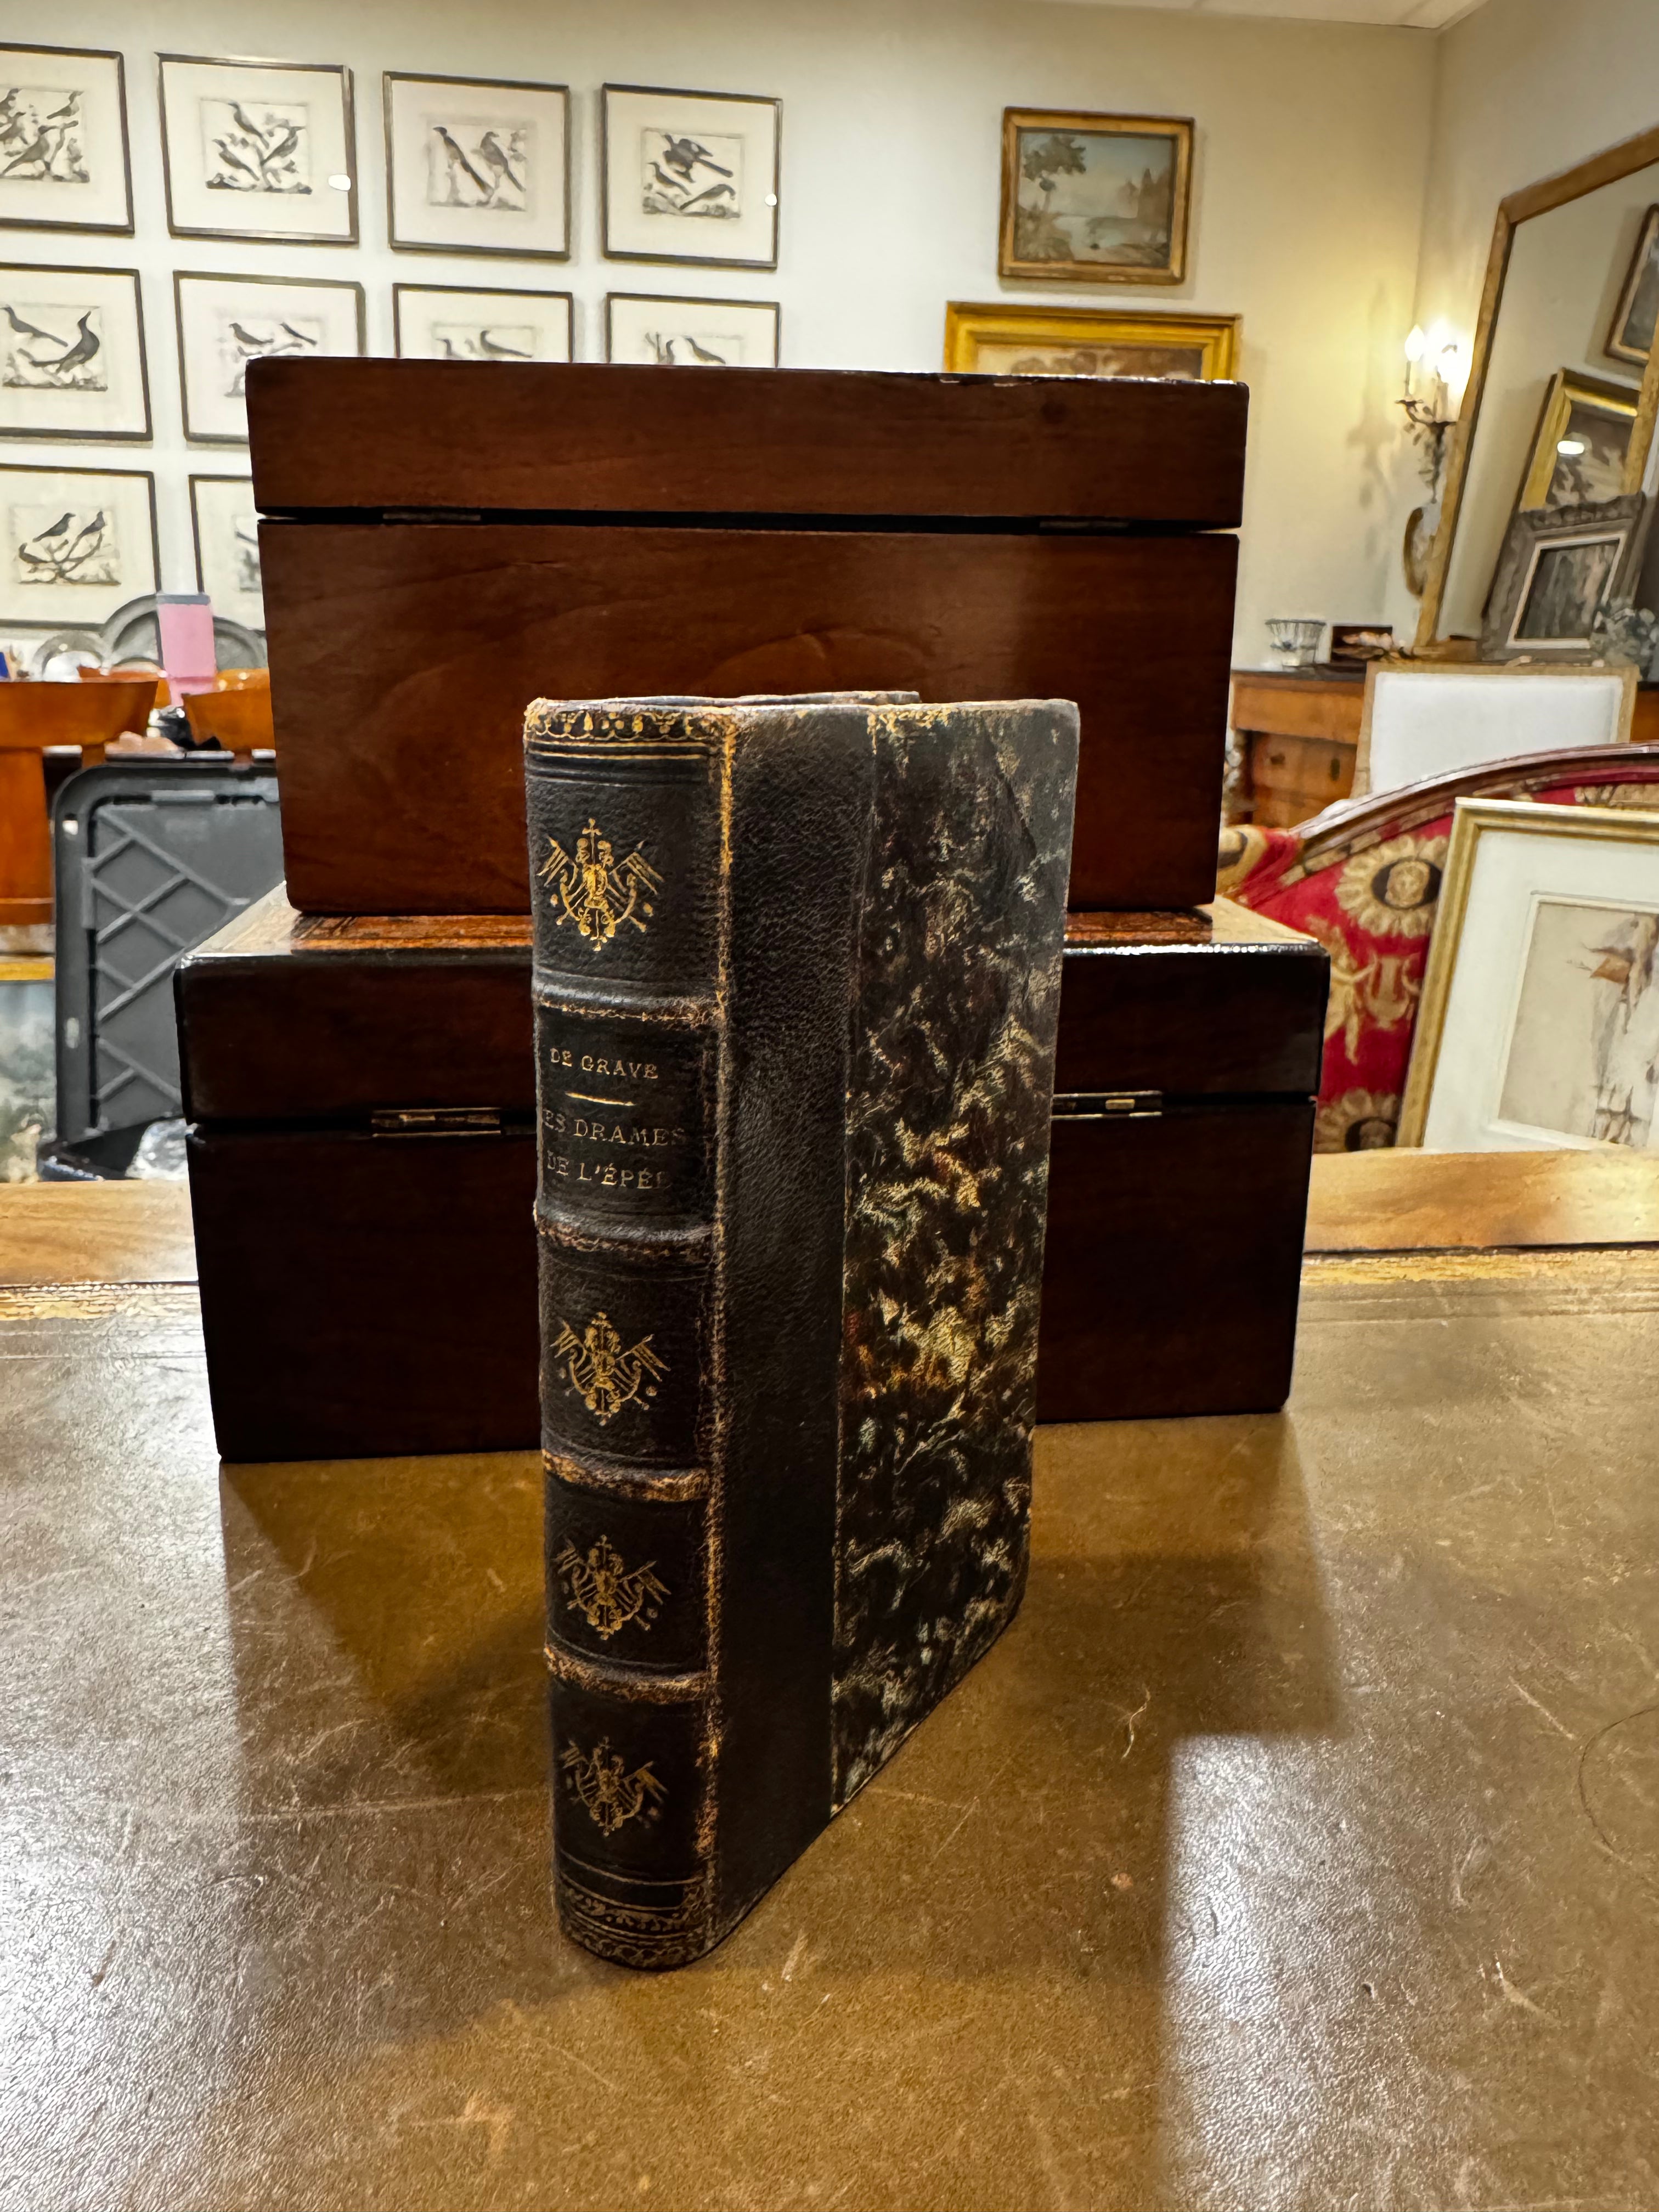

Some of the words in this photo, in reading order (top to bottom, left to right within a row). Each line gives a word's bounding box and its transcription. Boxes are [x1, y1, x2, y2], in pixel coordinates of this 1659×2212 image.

[550, 1047, 572, 1067] DE
[580, 1055, 659, 1079] GRAVE
[542, 1109, 566, 1133] ES
